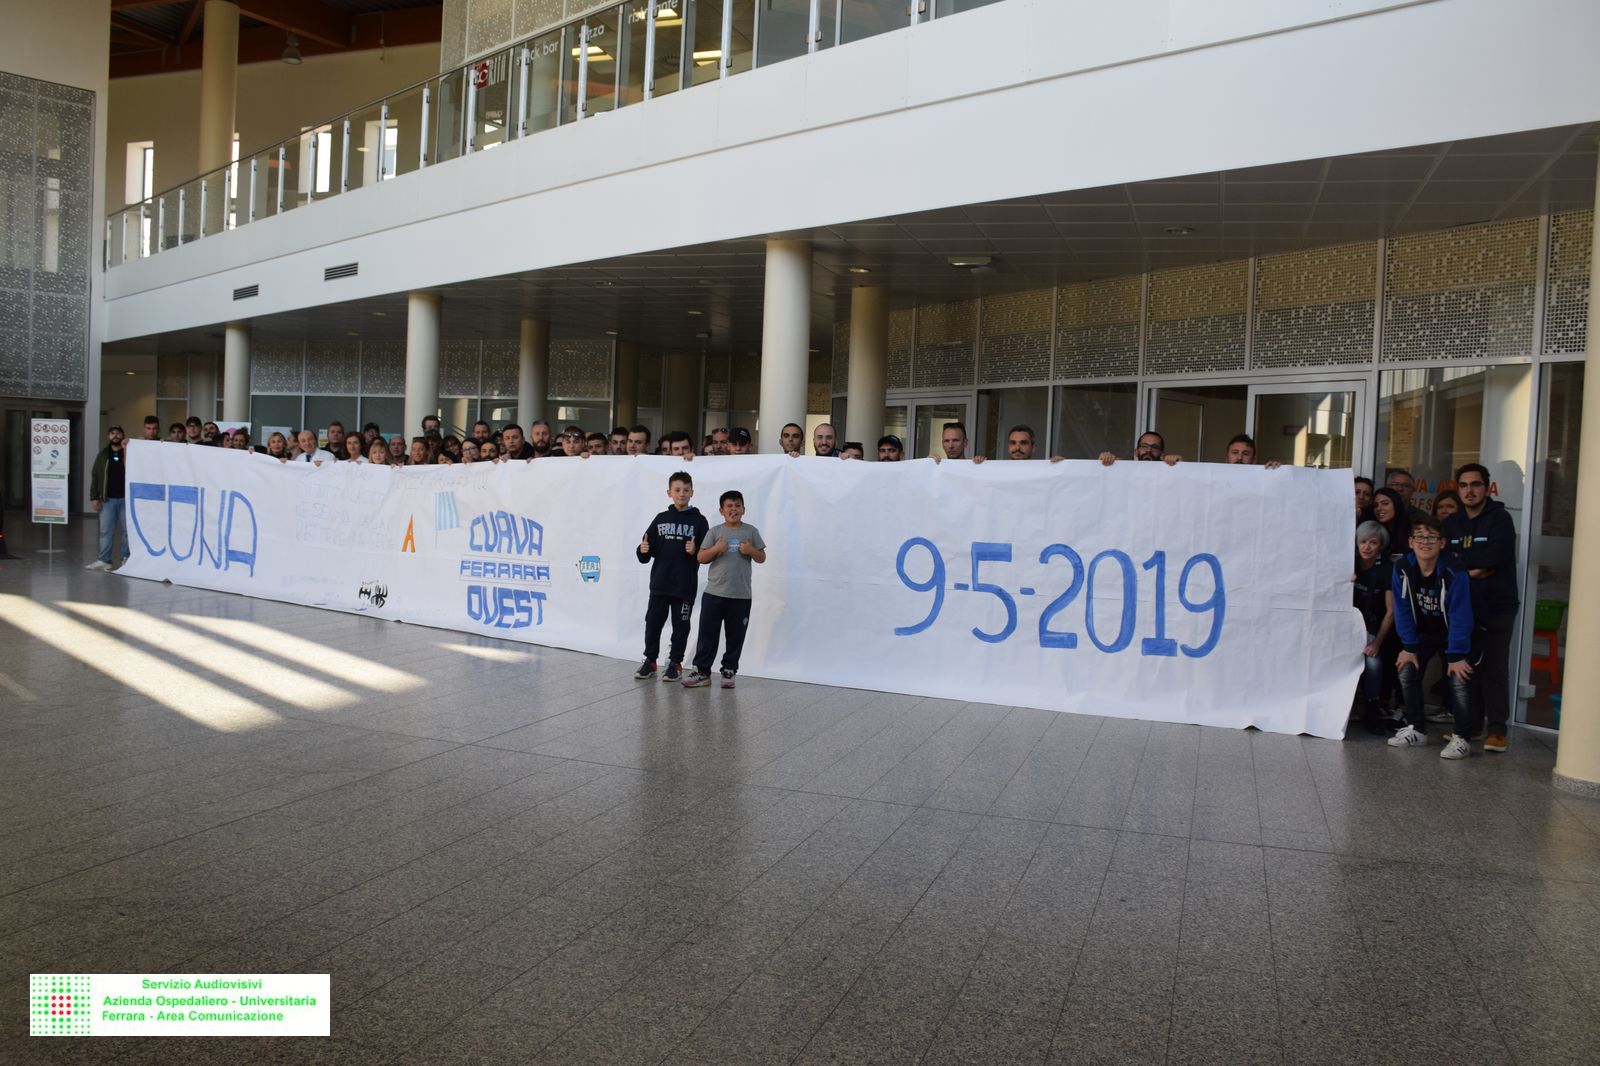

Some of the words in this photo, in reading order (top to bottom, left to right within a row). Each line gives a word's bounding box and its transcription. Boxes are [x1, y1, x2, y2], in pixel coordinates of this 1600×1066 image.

[543, 41, 559, 55] bar
[130, 482, 257, 577] CONA
[657, 523, 695, 537] FERRARA
[460, 560, 550, 580] FERRARA
[467, 585, 547, 628] OVEST
[894, 537, 1226, 658] 9-5-2019
